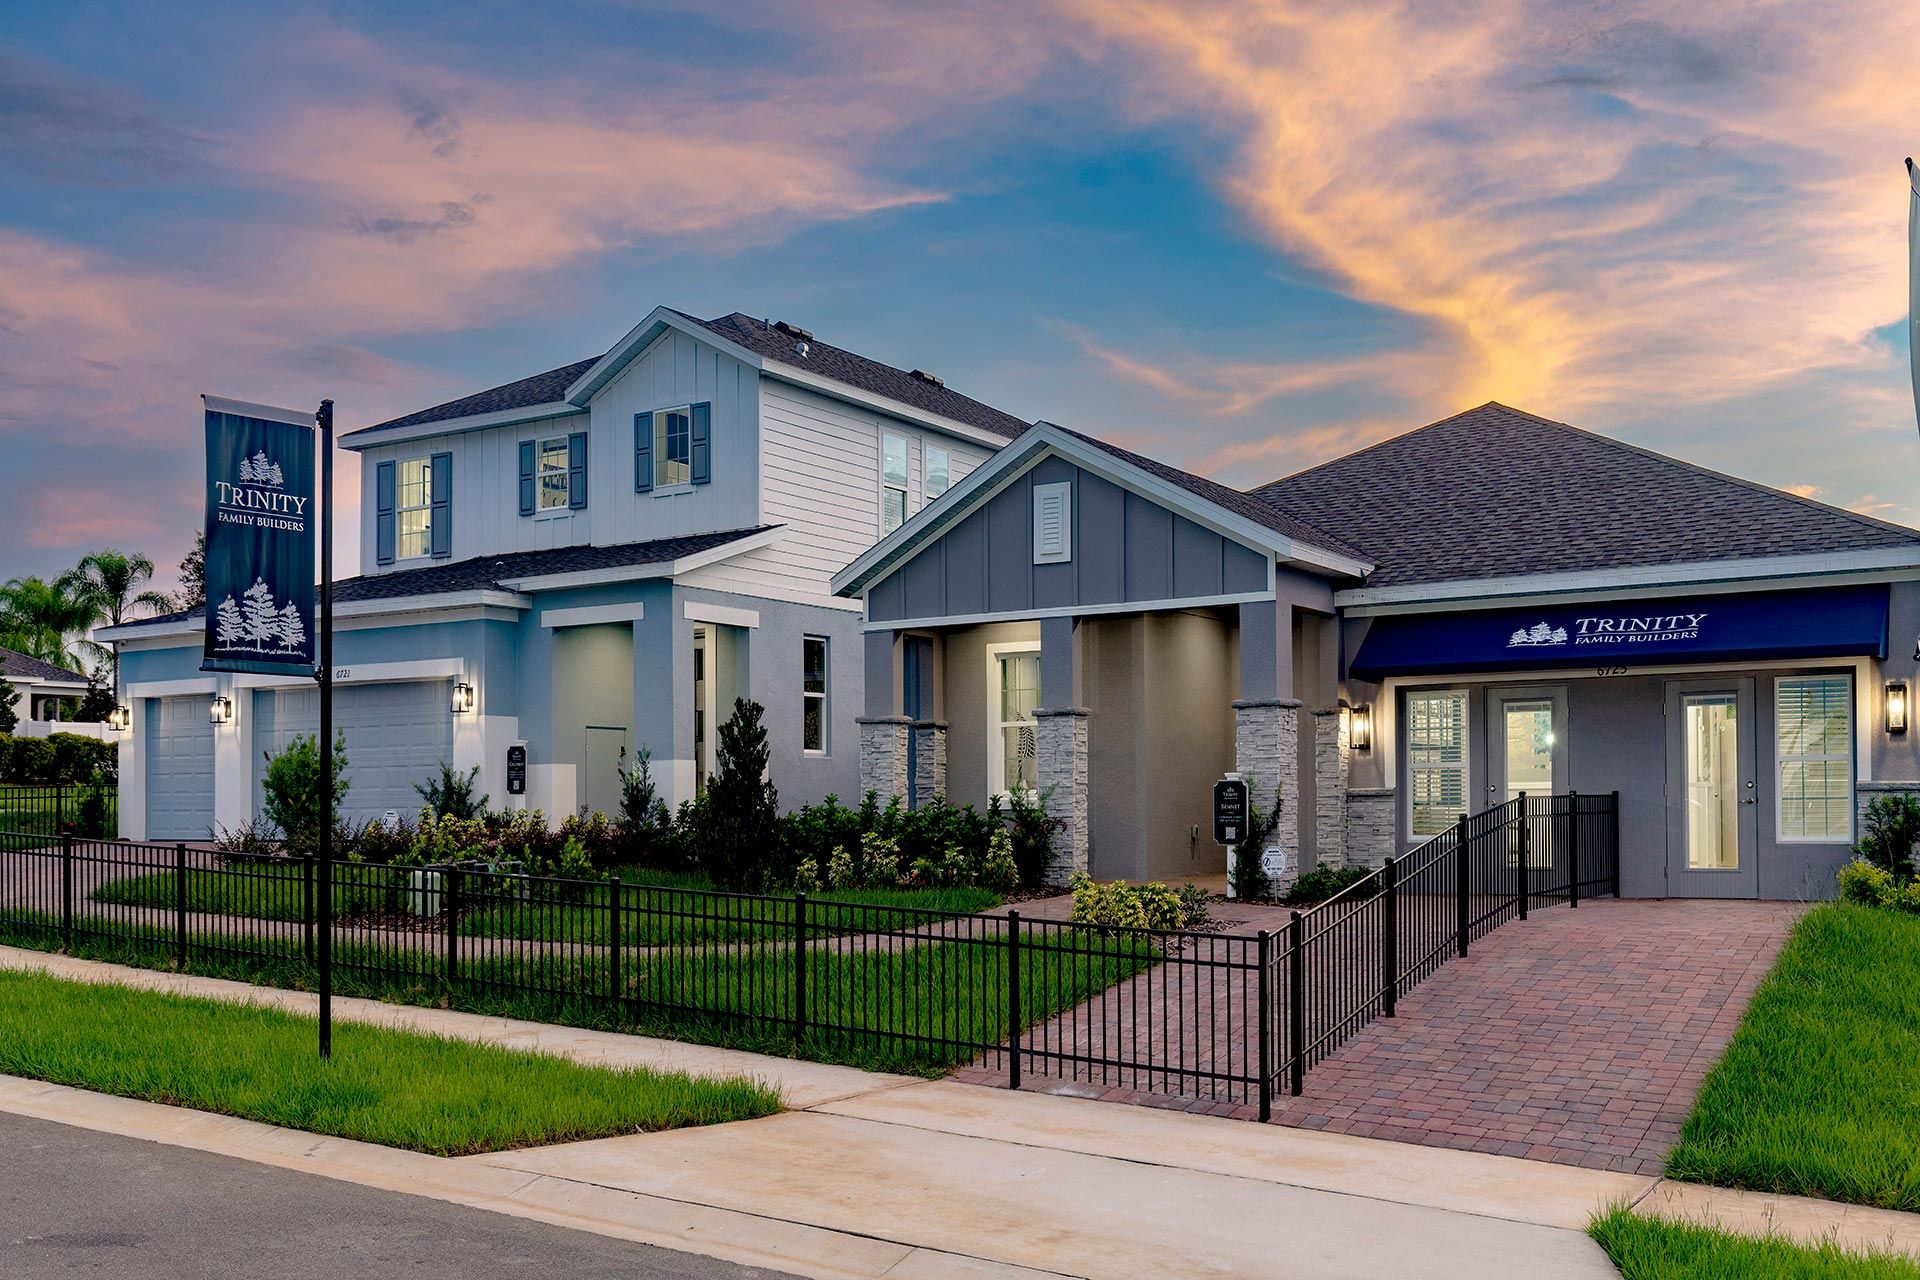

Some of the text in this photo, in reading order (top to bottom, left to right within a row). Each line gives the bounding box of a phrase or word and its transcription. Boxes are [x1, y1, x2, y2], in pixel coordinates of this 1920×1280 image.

[216, 481, 307, 515] TRINITY
[218, 511, 304, 532] FAMILY BUILDERS
[1575, 613, 1708, 634] TRINITY
[1575, 631, 1698, 645] FAMILY BUILDERS
[335, 669, 351, 679] 6721
